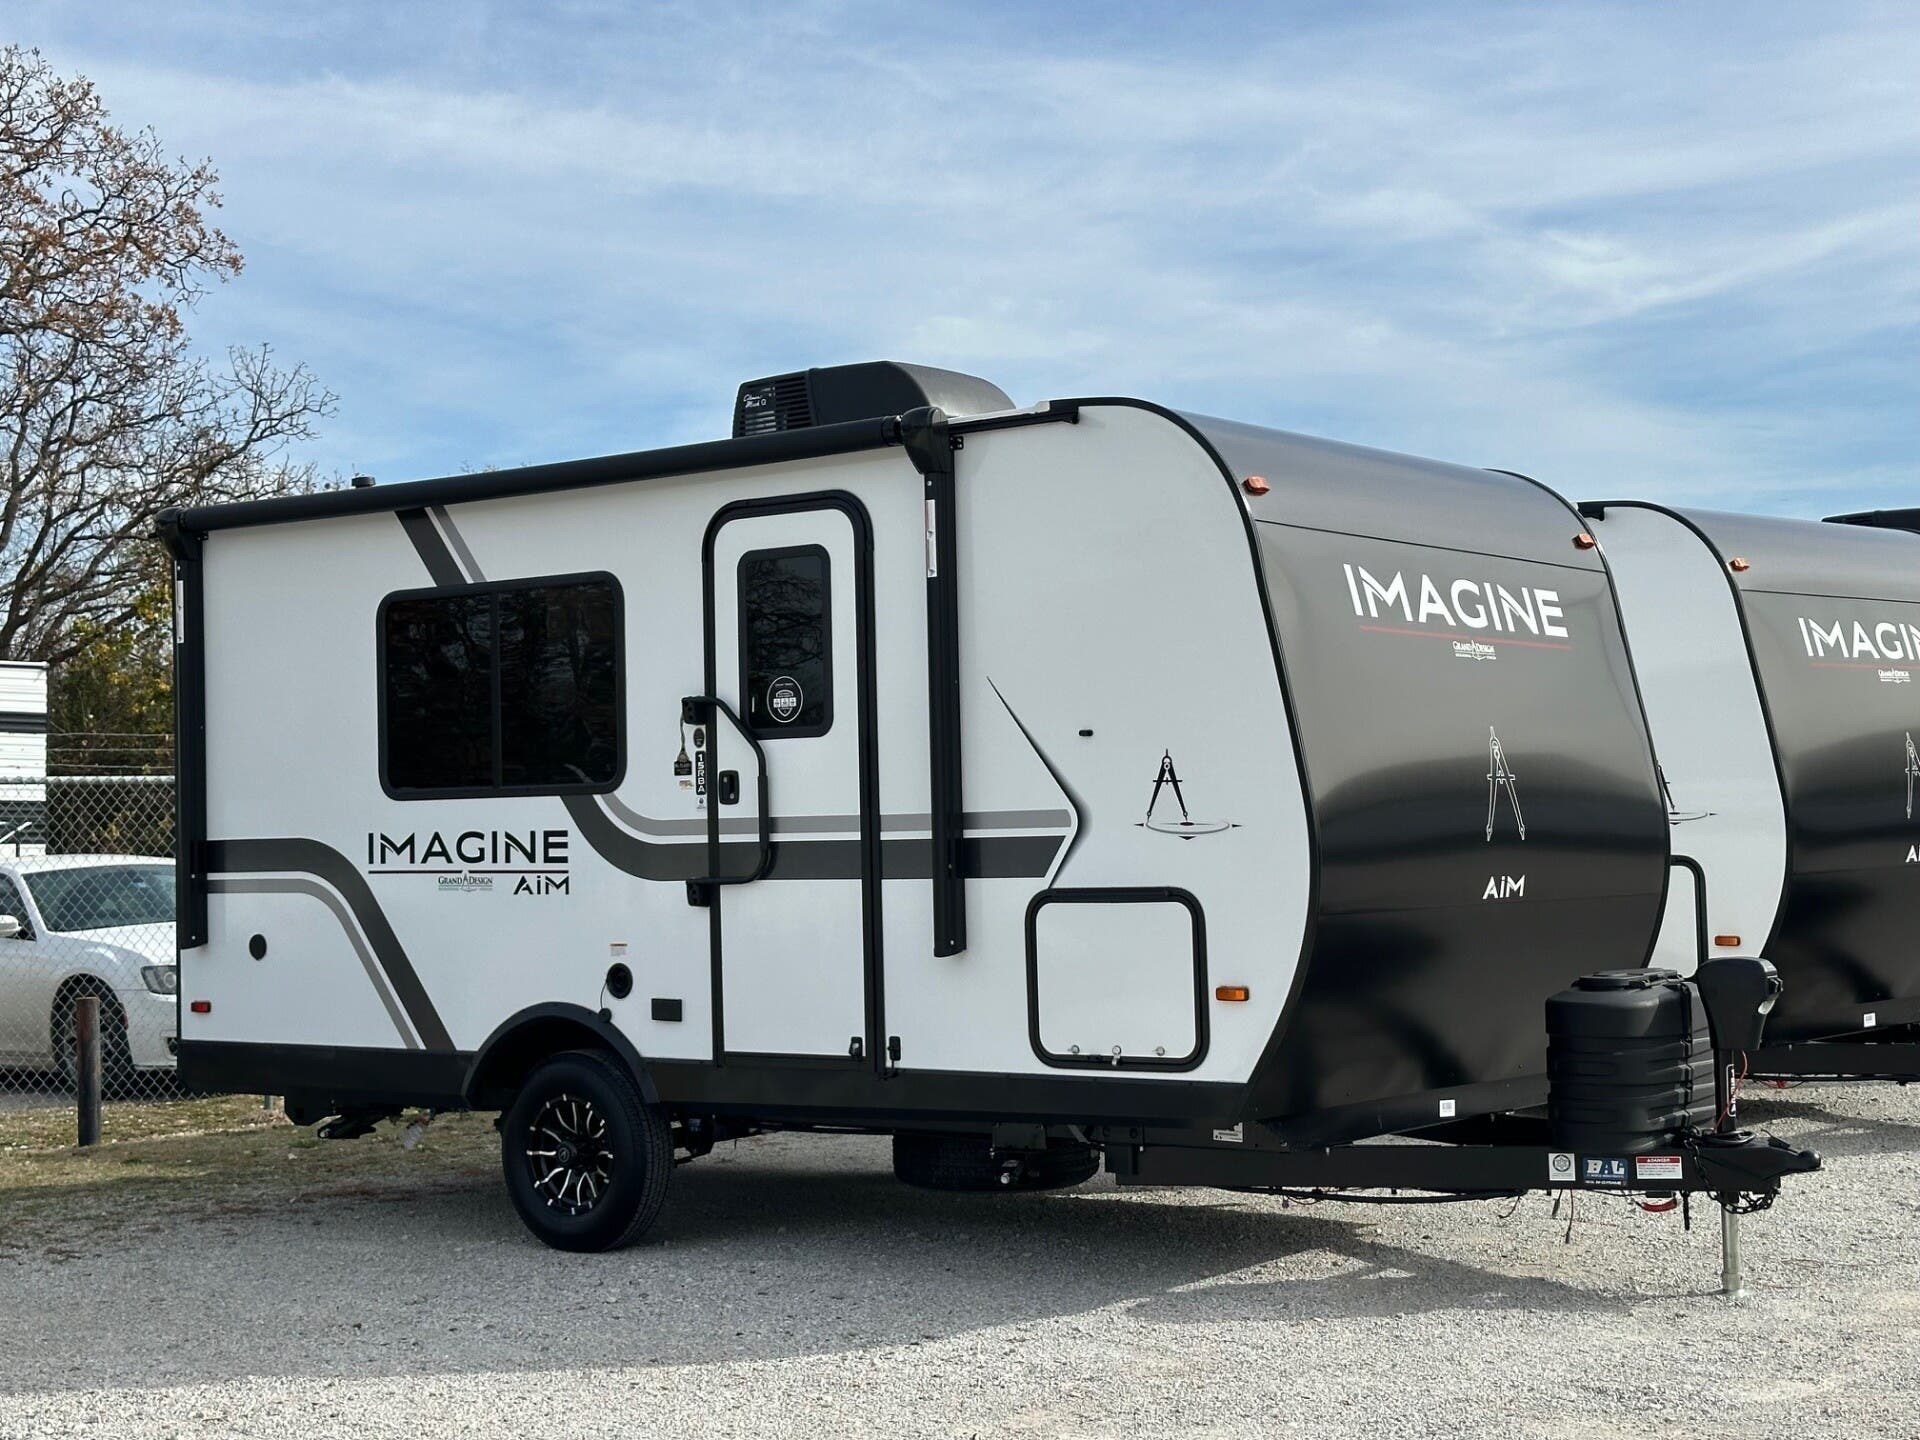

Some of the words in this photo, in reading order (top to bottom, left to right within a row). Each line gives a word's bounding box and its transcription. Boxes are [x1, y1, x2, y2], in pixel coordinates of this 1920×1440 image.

[1343, 563, 1569, 638] IMAGINE
[368, 830, 569, 864] IMAGINE
[438, 876, 462, 885] GRAND
[469, 876, 493, 885] DESIGN
